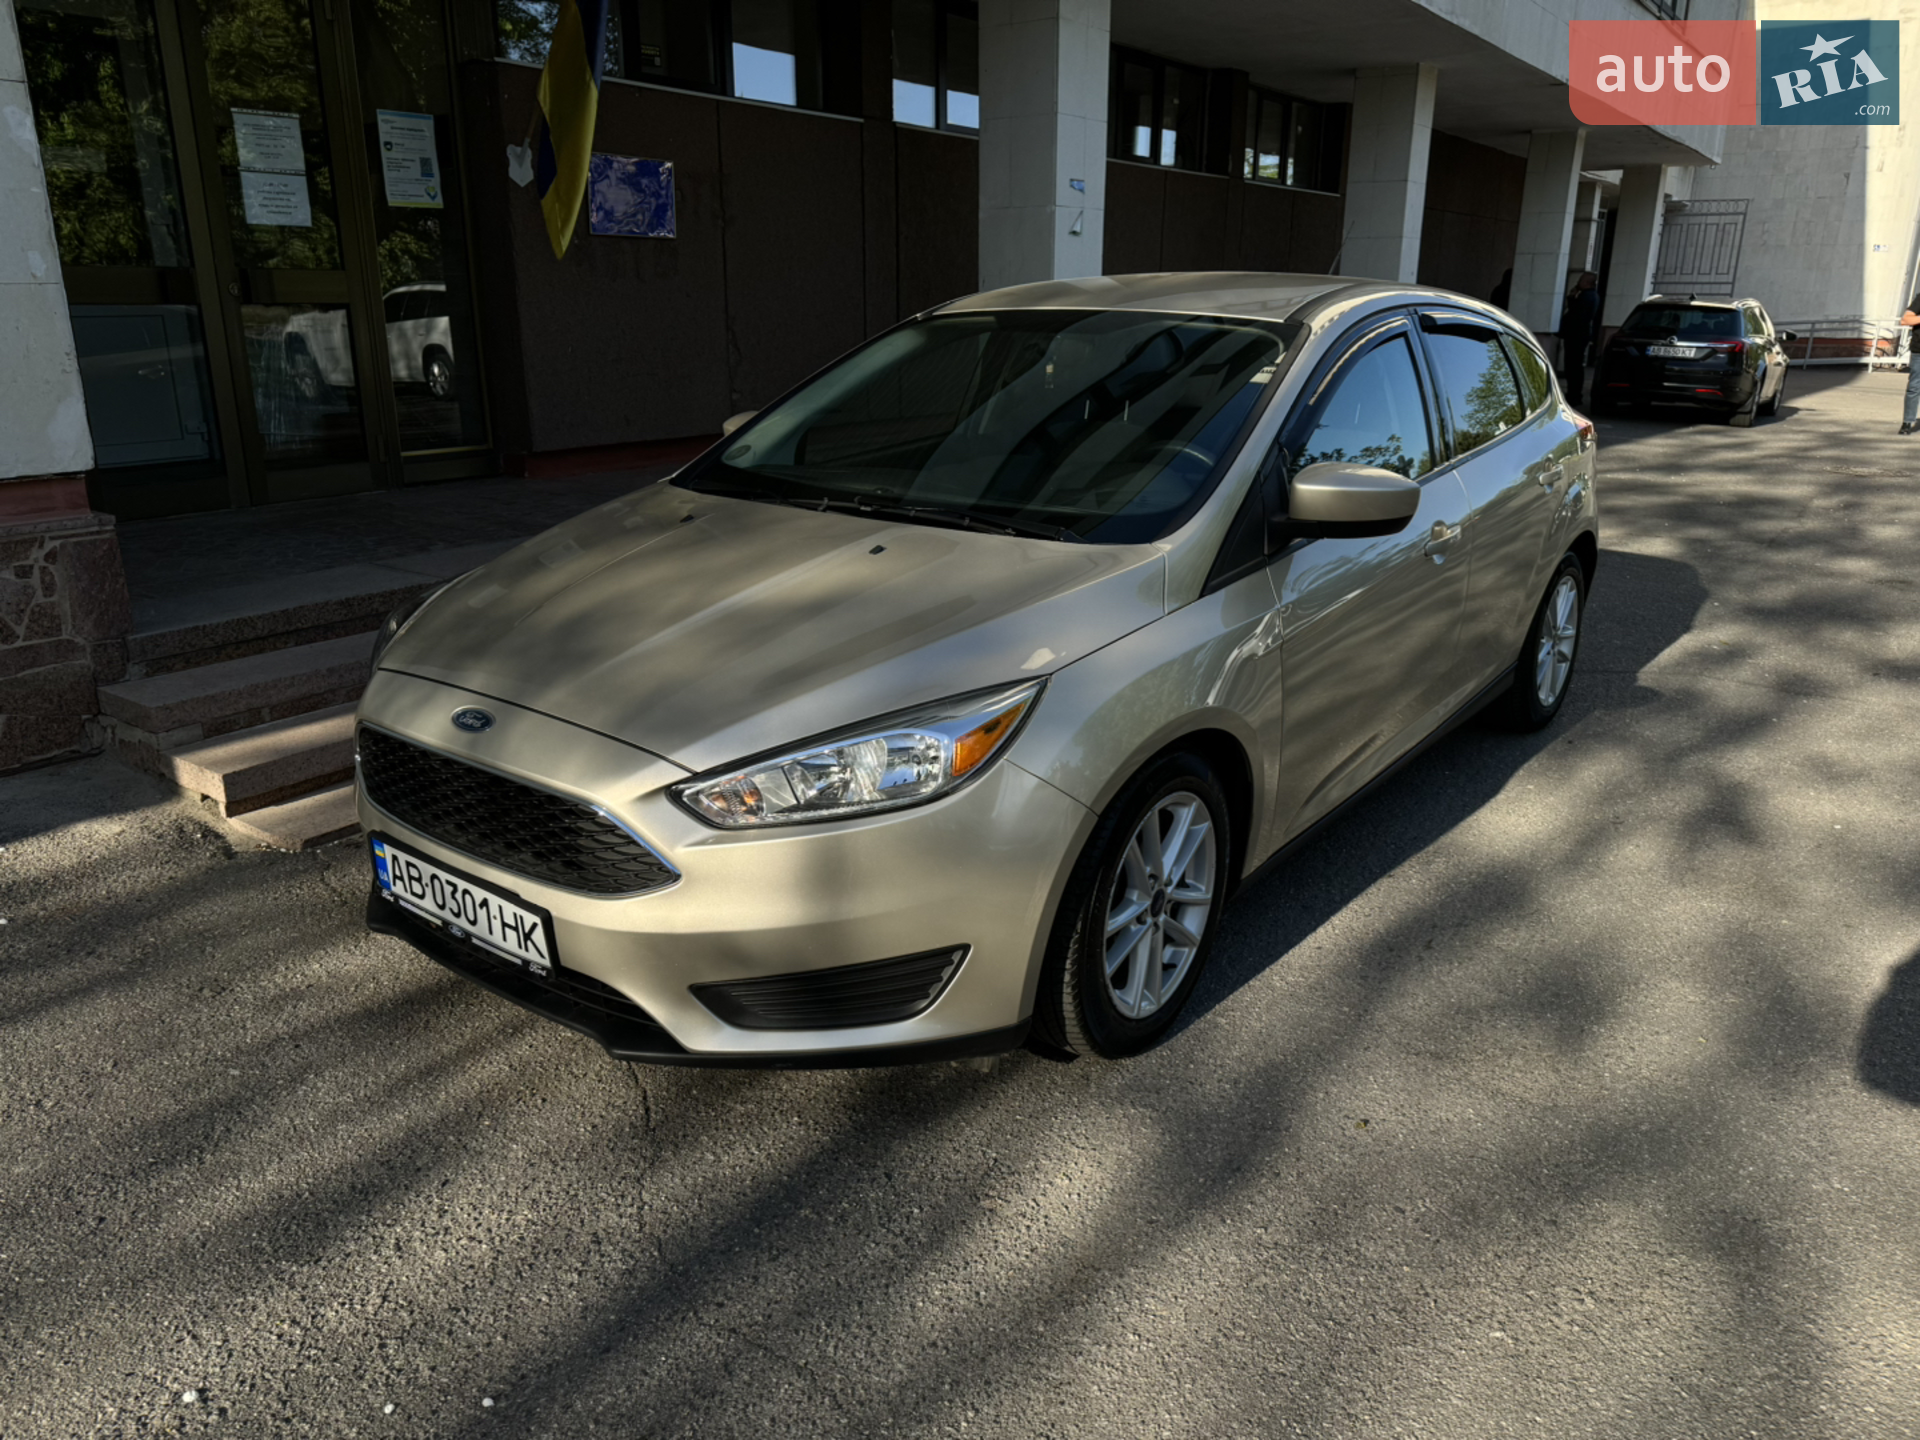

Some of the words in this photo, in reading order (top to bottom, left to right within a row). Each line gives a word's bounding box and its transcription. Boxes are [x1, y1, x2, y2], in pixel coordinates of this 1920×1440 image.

[459, 711, 486, 728] Ford
[378, 867, 390, 880] UA
[528, 962, 547, 977] Ford
